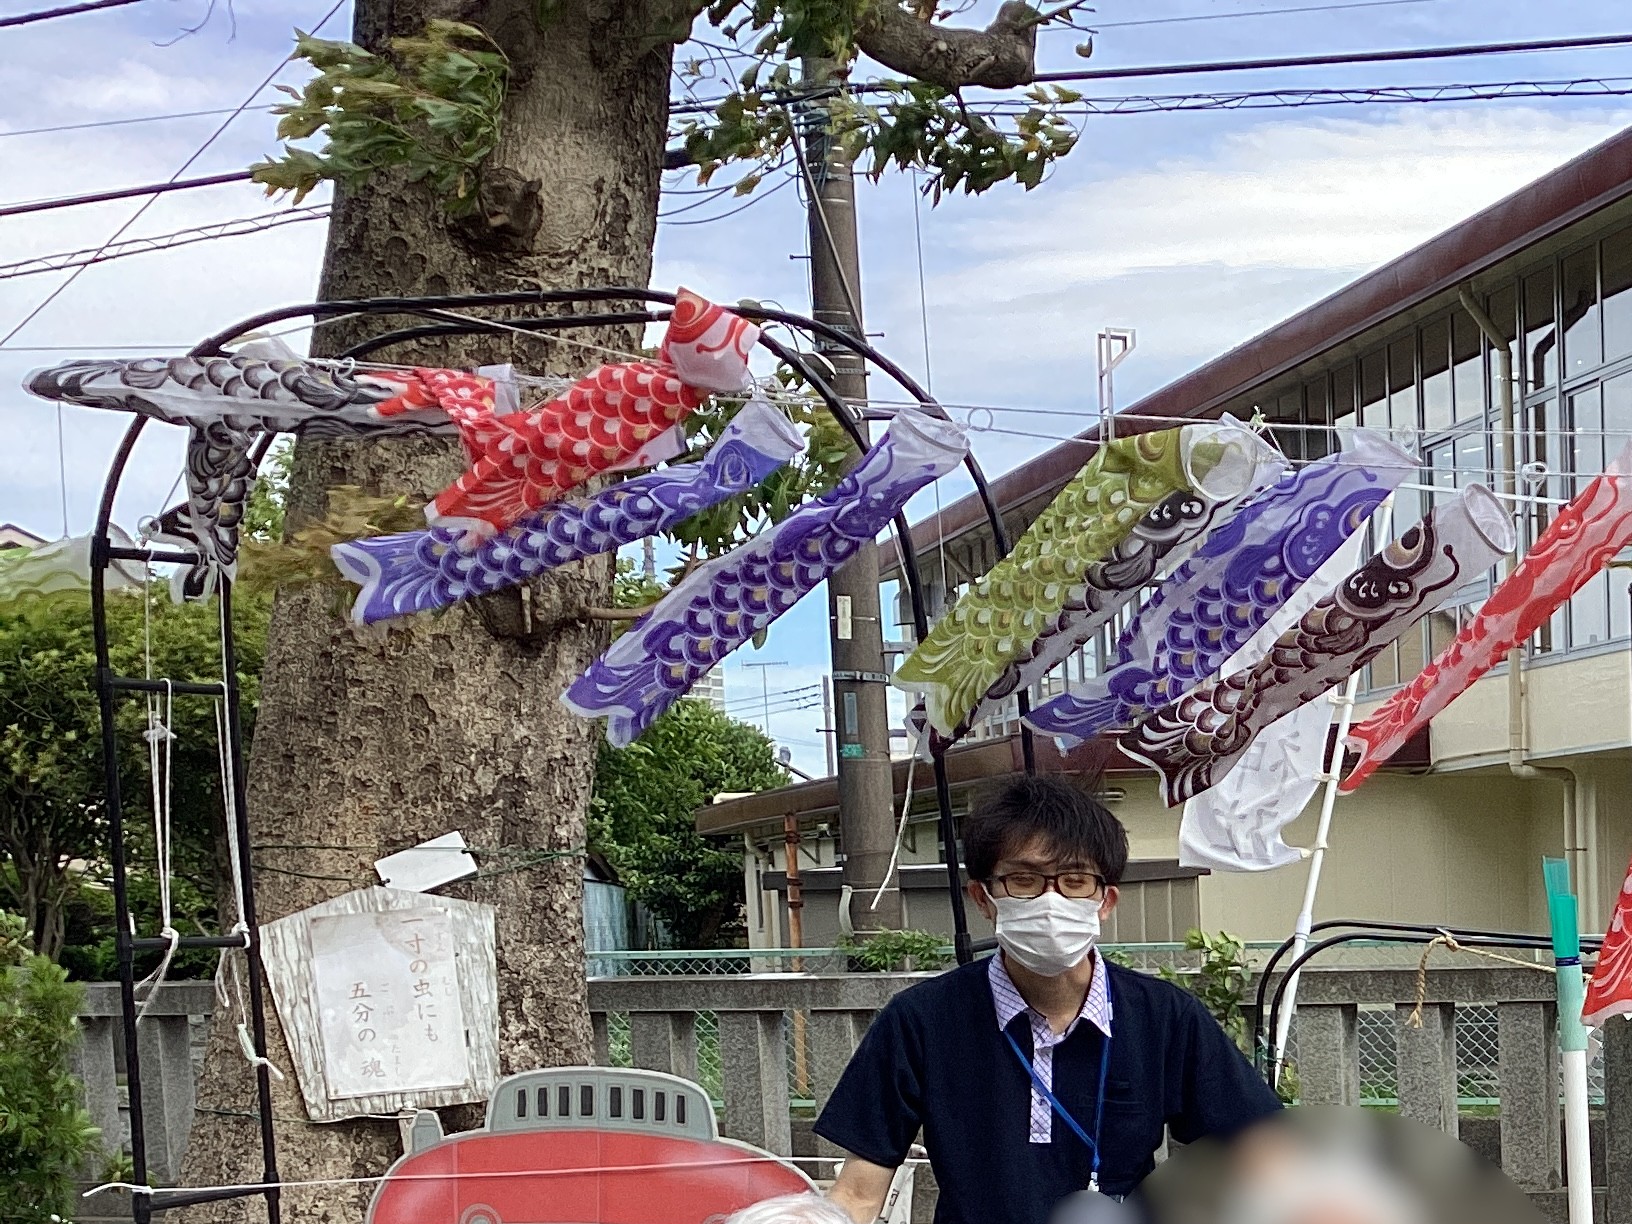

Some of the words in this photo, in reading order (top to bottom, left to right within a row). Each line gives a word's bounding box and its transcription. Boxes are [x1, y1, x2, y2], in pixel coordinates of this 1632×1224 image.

[349, 981, 387, 1078] 五分の魂
[401, 918, 439, 1042] 一寸の虫にも
